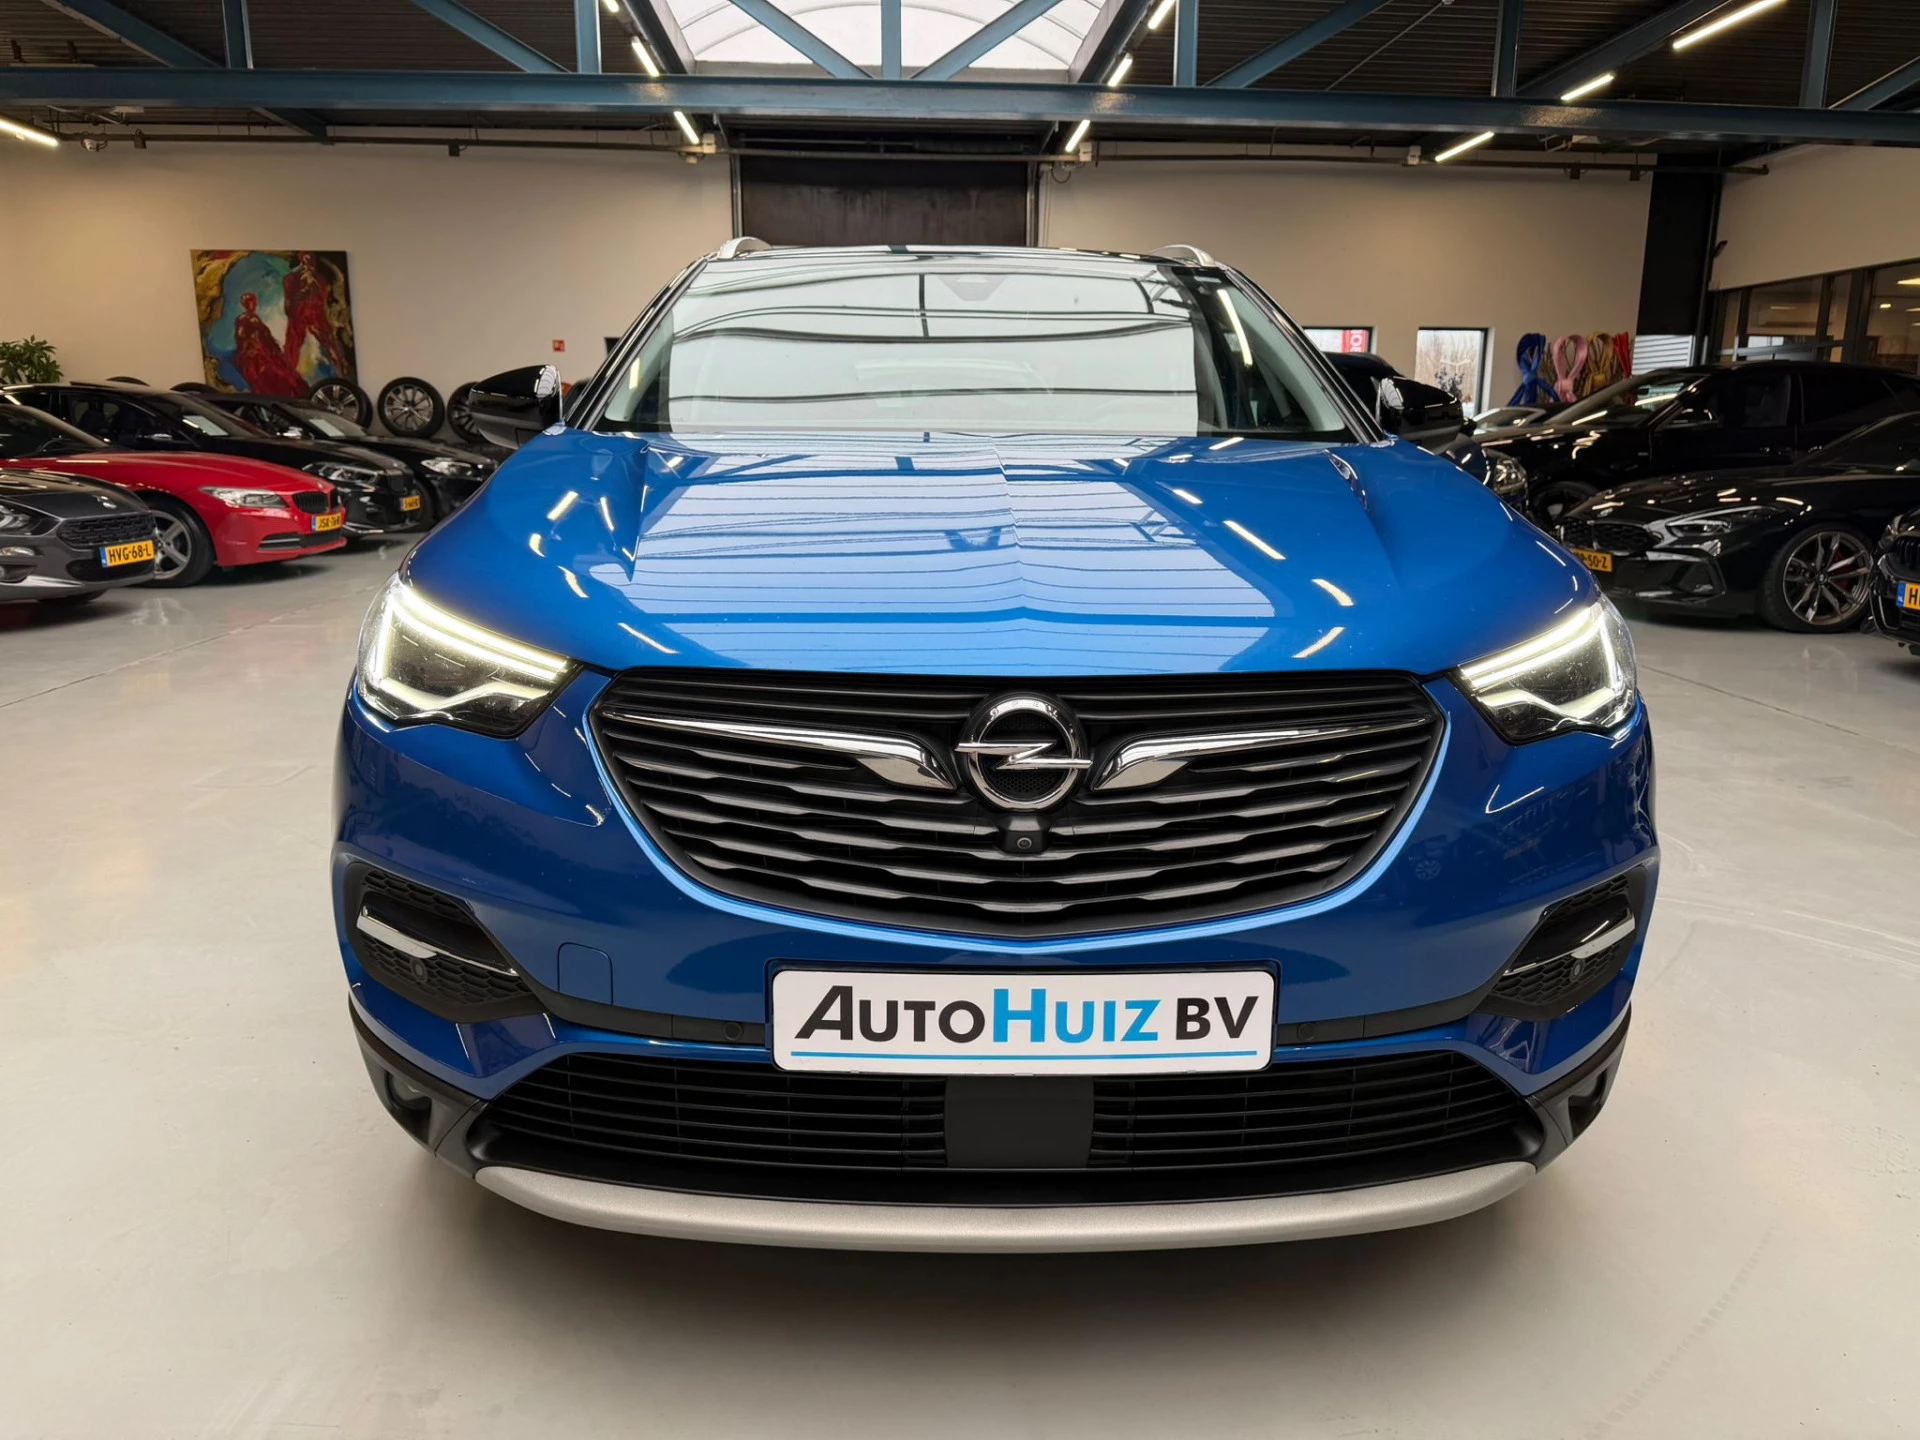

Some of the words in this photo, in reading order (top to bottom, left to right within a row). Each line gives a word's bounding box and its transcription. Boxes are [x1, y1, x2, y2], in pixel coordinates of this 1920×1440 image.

[108, 543, 152, 563] HVG-68-L
[794, 985, 1162, 1044] AUTOHUIZ
[1175, 996, 1260, 1041] BV
